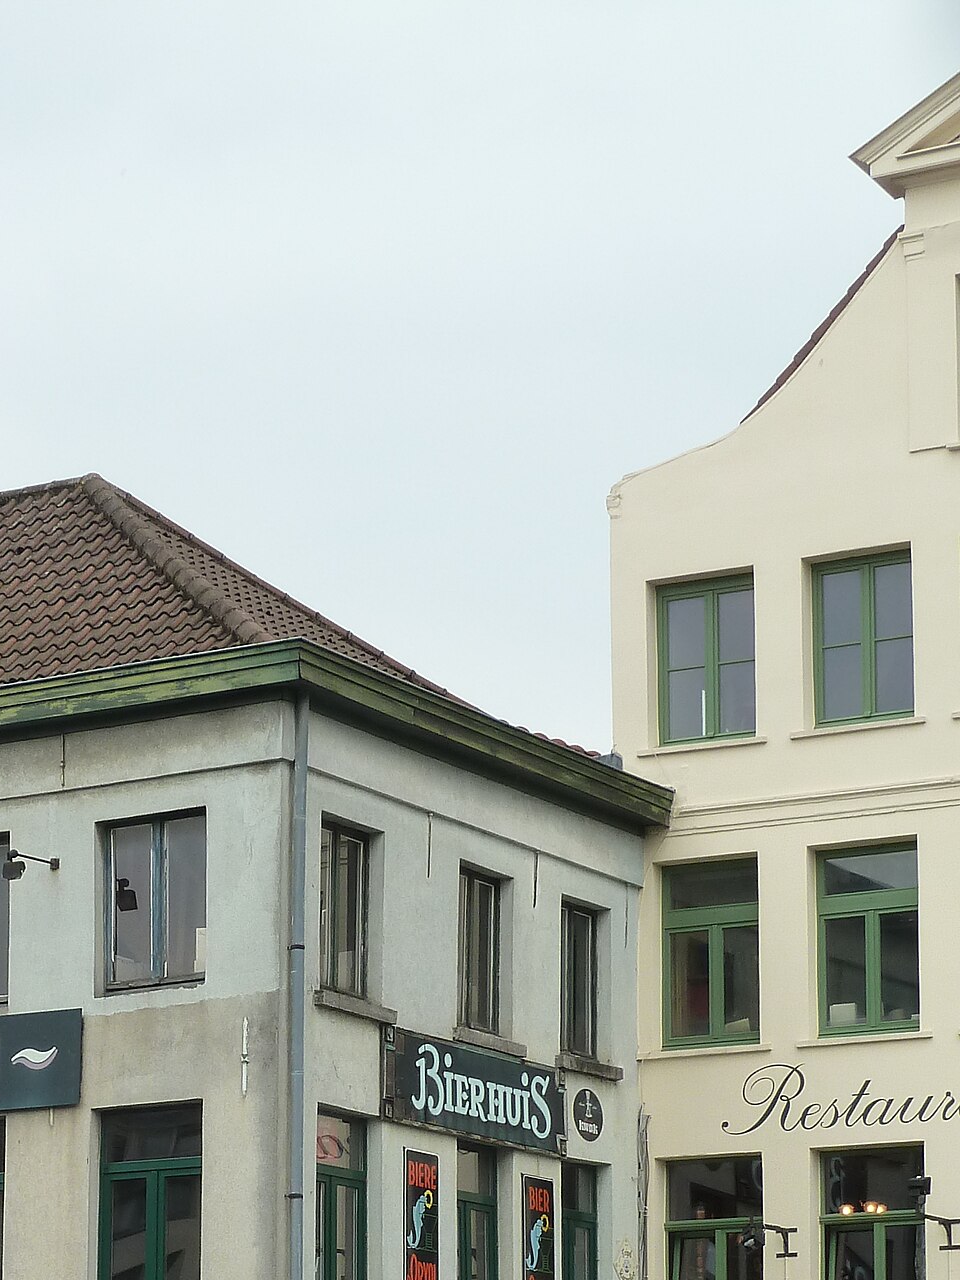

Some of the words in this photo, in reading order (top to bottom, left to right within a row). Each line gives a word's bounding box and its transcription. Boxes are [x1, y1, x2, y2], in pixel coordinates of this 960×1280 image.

[721, 1063, 960, 1136] Restaur
[407, 1160, 437, 1190] BIERE
[528, 1186, 550, 1213] BIER
